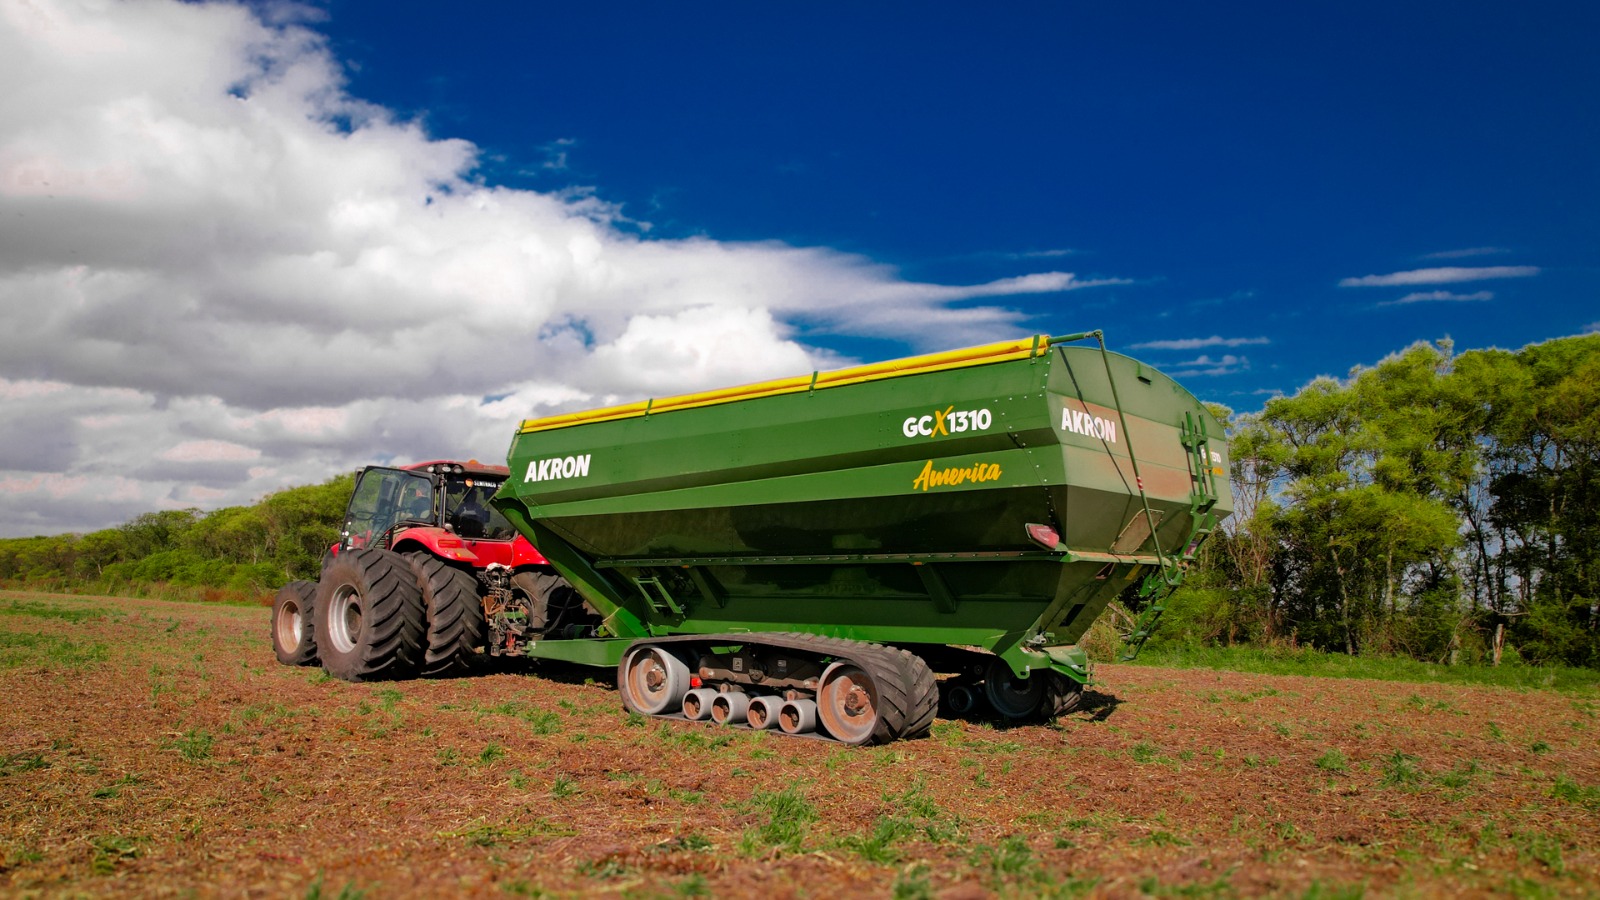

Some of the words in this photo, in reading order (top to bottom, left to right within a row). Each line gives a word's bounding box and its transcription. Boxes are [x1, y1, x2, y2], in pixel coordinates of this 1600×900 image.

[903, 405, 992, 438] GCX1310
[1061, 407, 1117, 443] AKRON
[524, 454, 591, 483] AKRON
[913, 460, 1002, 491] America
